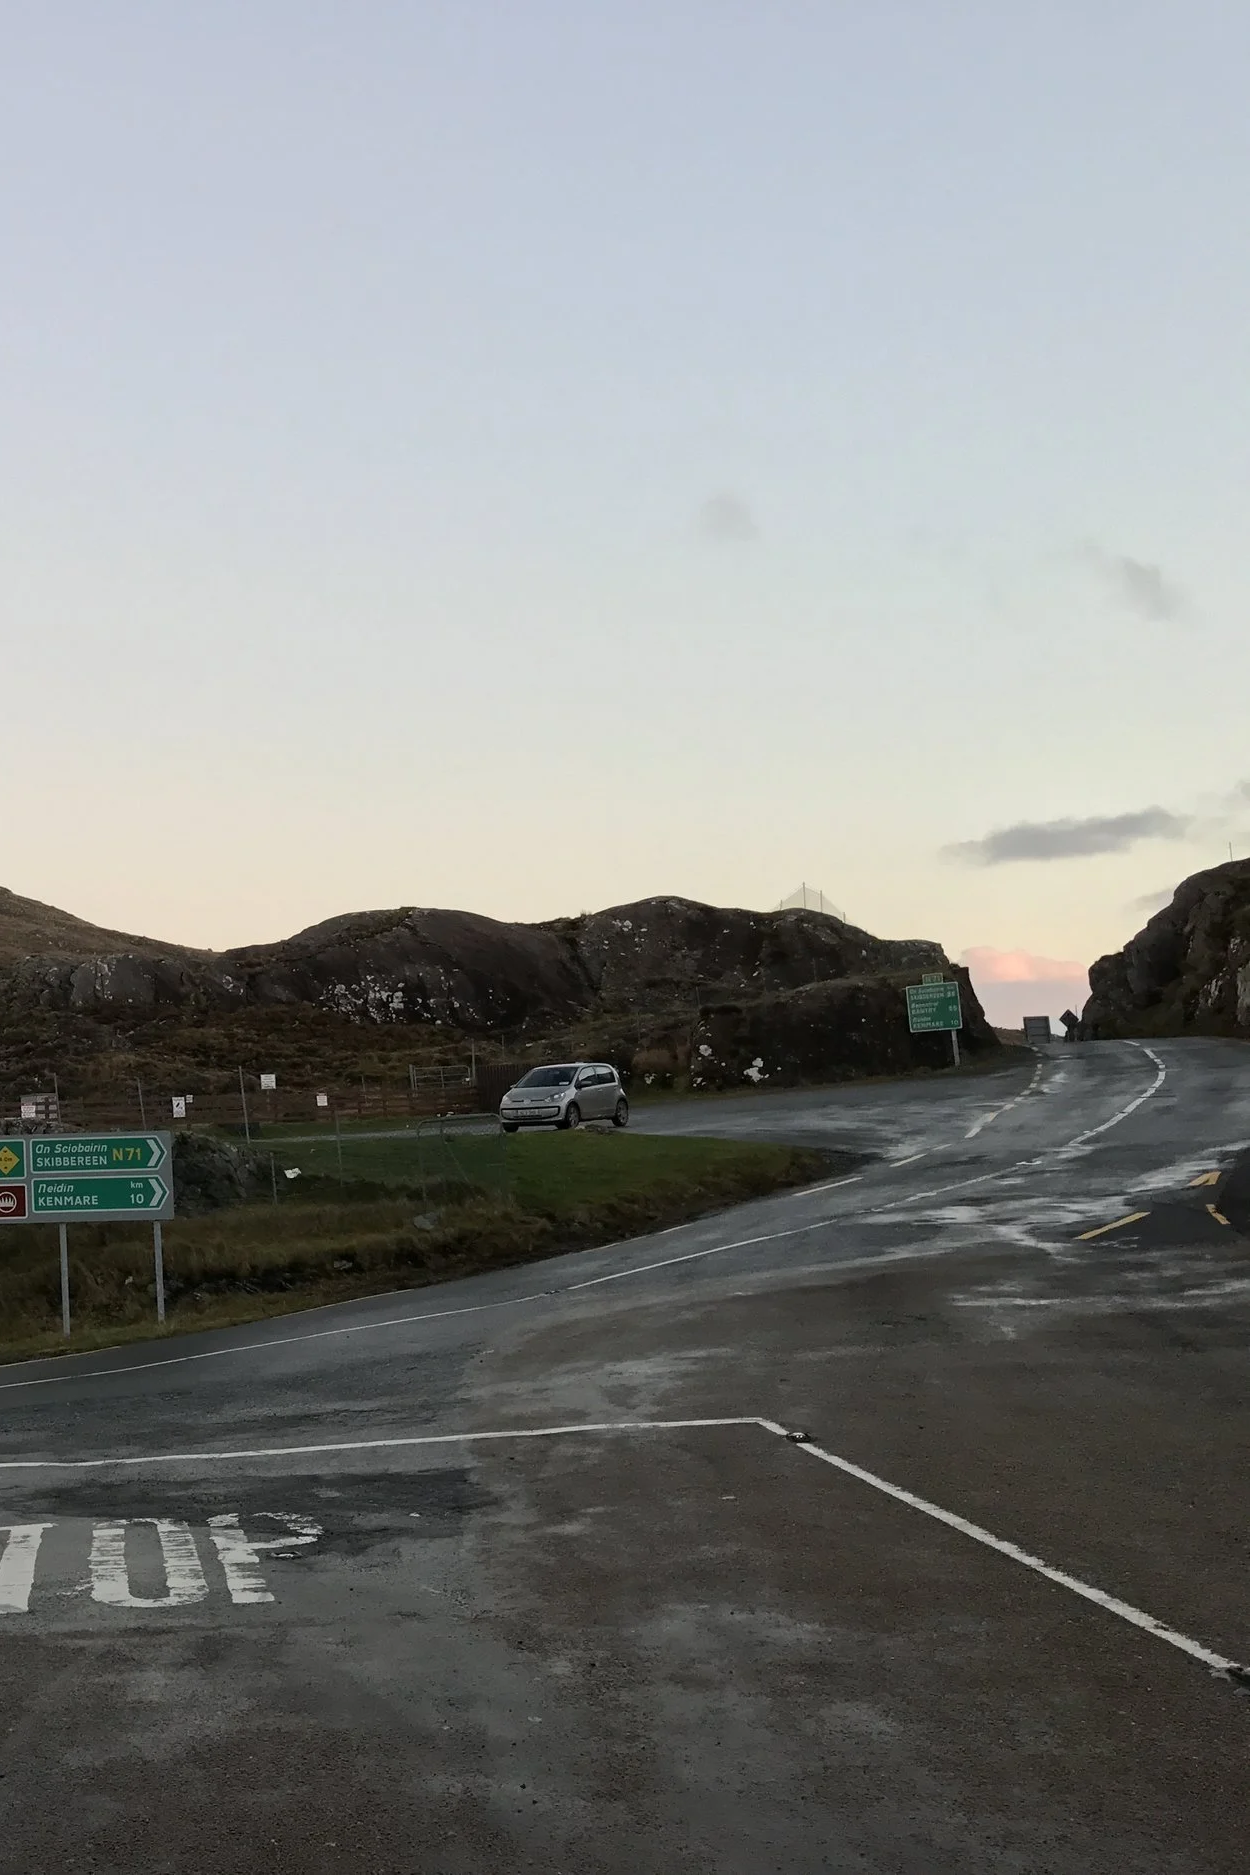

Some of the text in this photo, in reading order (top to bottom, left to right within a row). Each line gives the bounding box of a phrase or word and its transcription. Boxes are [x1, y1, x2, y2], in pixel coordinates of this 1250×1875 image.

[36, 1156, 108, 1168] SKIBBEREEN
[130, 1181, 144, 1189] km
[38, 1195, 99, 1207] KENMARE
[130, 1193, 145, 1205] 10
